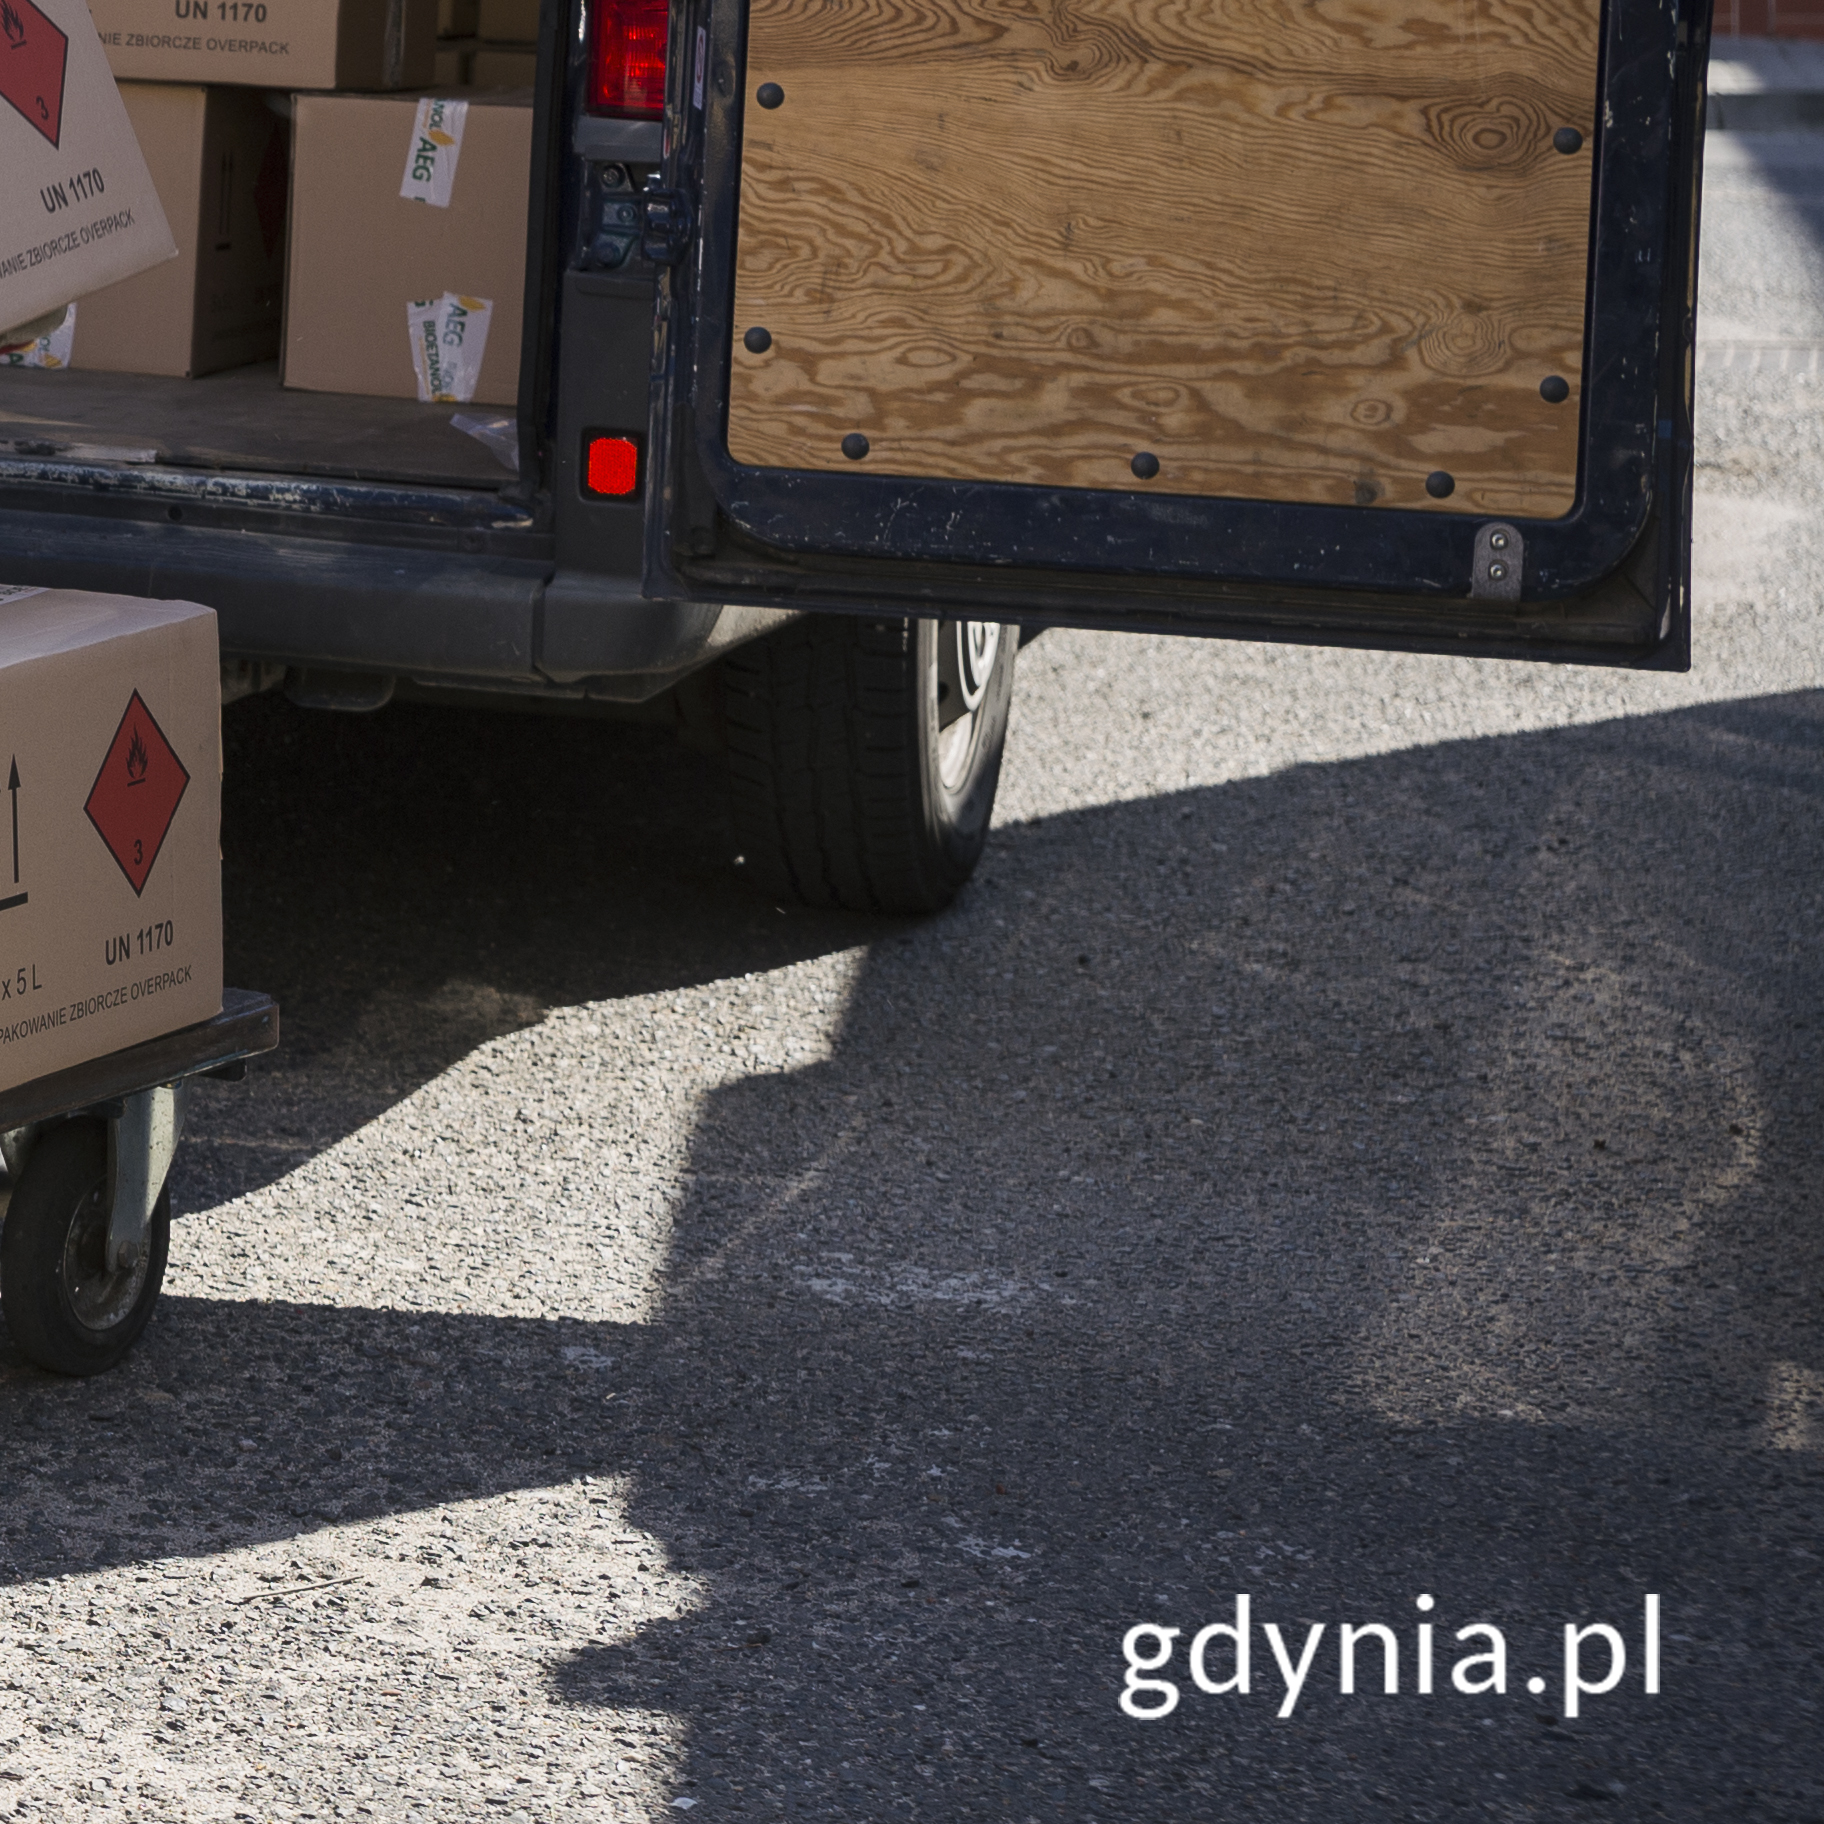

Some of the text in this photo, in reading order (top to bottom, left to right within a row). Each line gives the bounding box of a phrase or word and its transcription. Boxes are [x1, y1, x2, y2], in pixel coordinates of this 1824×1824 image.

[217, 1, 268, 23] 1170
[125, 33, 202, 50] ZBIORCZE
[206, 37, 290, 55] OVERPACK
[35, 95, 49, 122] 3
[412, 136, 438, 183] AEG
[40, 167, 105, 214] UN 1170
[26, 230, 81, 268] ZBIORCZE
[79, 208, 136, 245] OVERPACK
[442, 302, 468, 348] AEG
[423, 320, 443, 394] BIOETANOL
[133, 839, 144, 866] 3
[105, 919, 174, 966] UN 1170
[16, 967, 27, 996] 5
[32, 963, 42, 990] L
[69, 986, 128, 1022] ZBIORCZE
[130, 965, 192, 1001] OVERPACK
